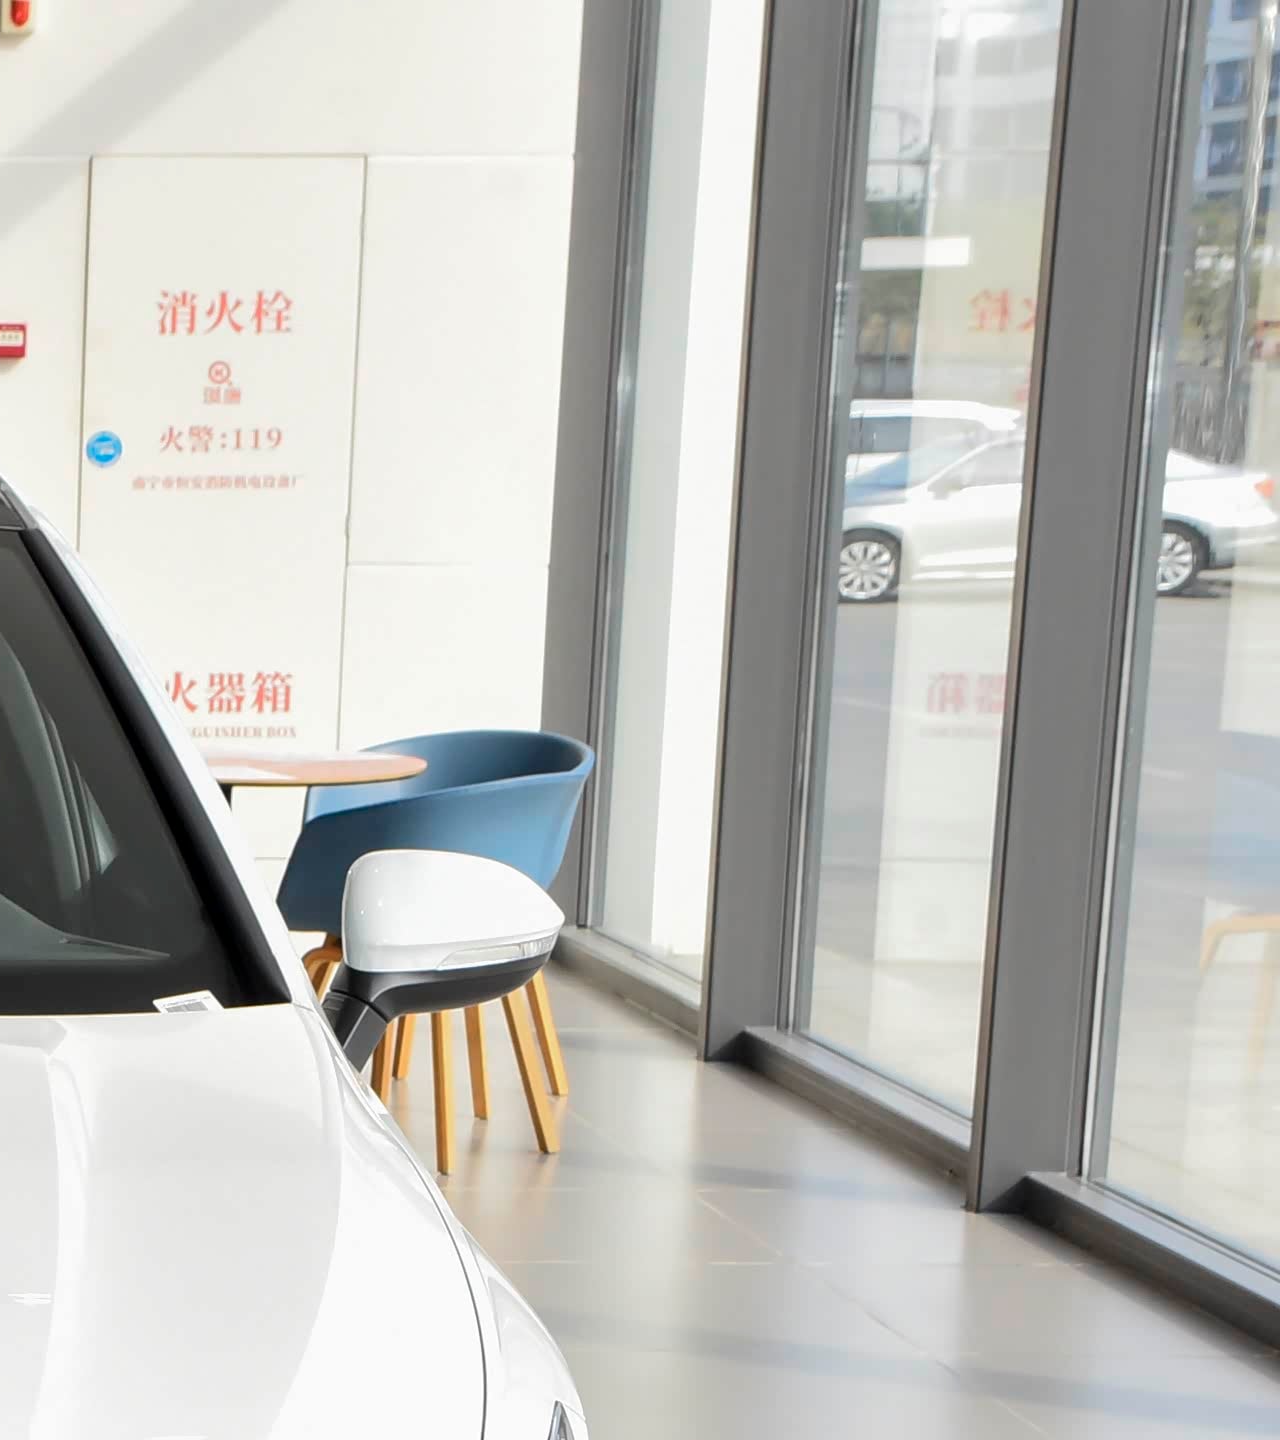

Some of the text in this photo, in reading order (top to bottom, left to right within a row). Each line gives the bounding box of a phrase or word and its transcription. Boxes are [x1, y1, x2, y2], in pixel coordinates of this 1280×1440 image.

[156, 289, 295, 337] 消火栓
[159, 424, 285, 453] 火警:119
[266, 726, 297, 738] BOX
